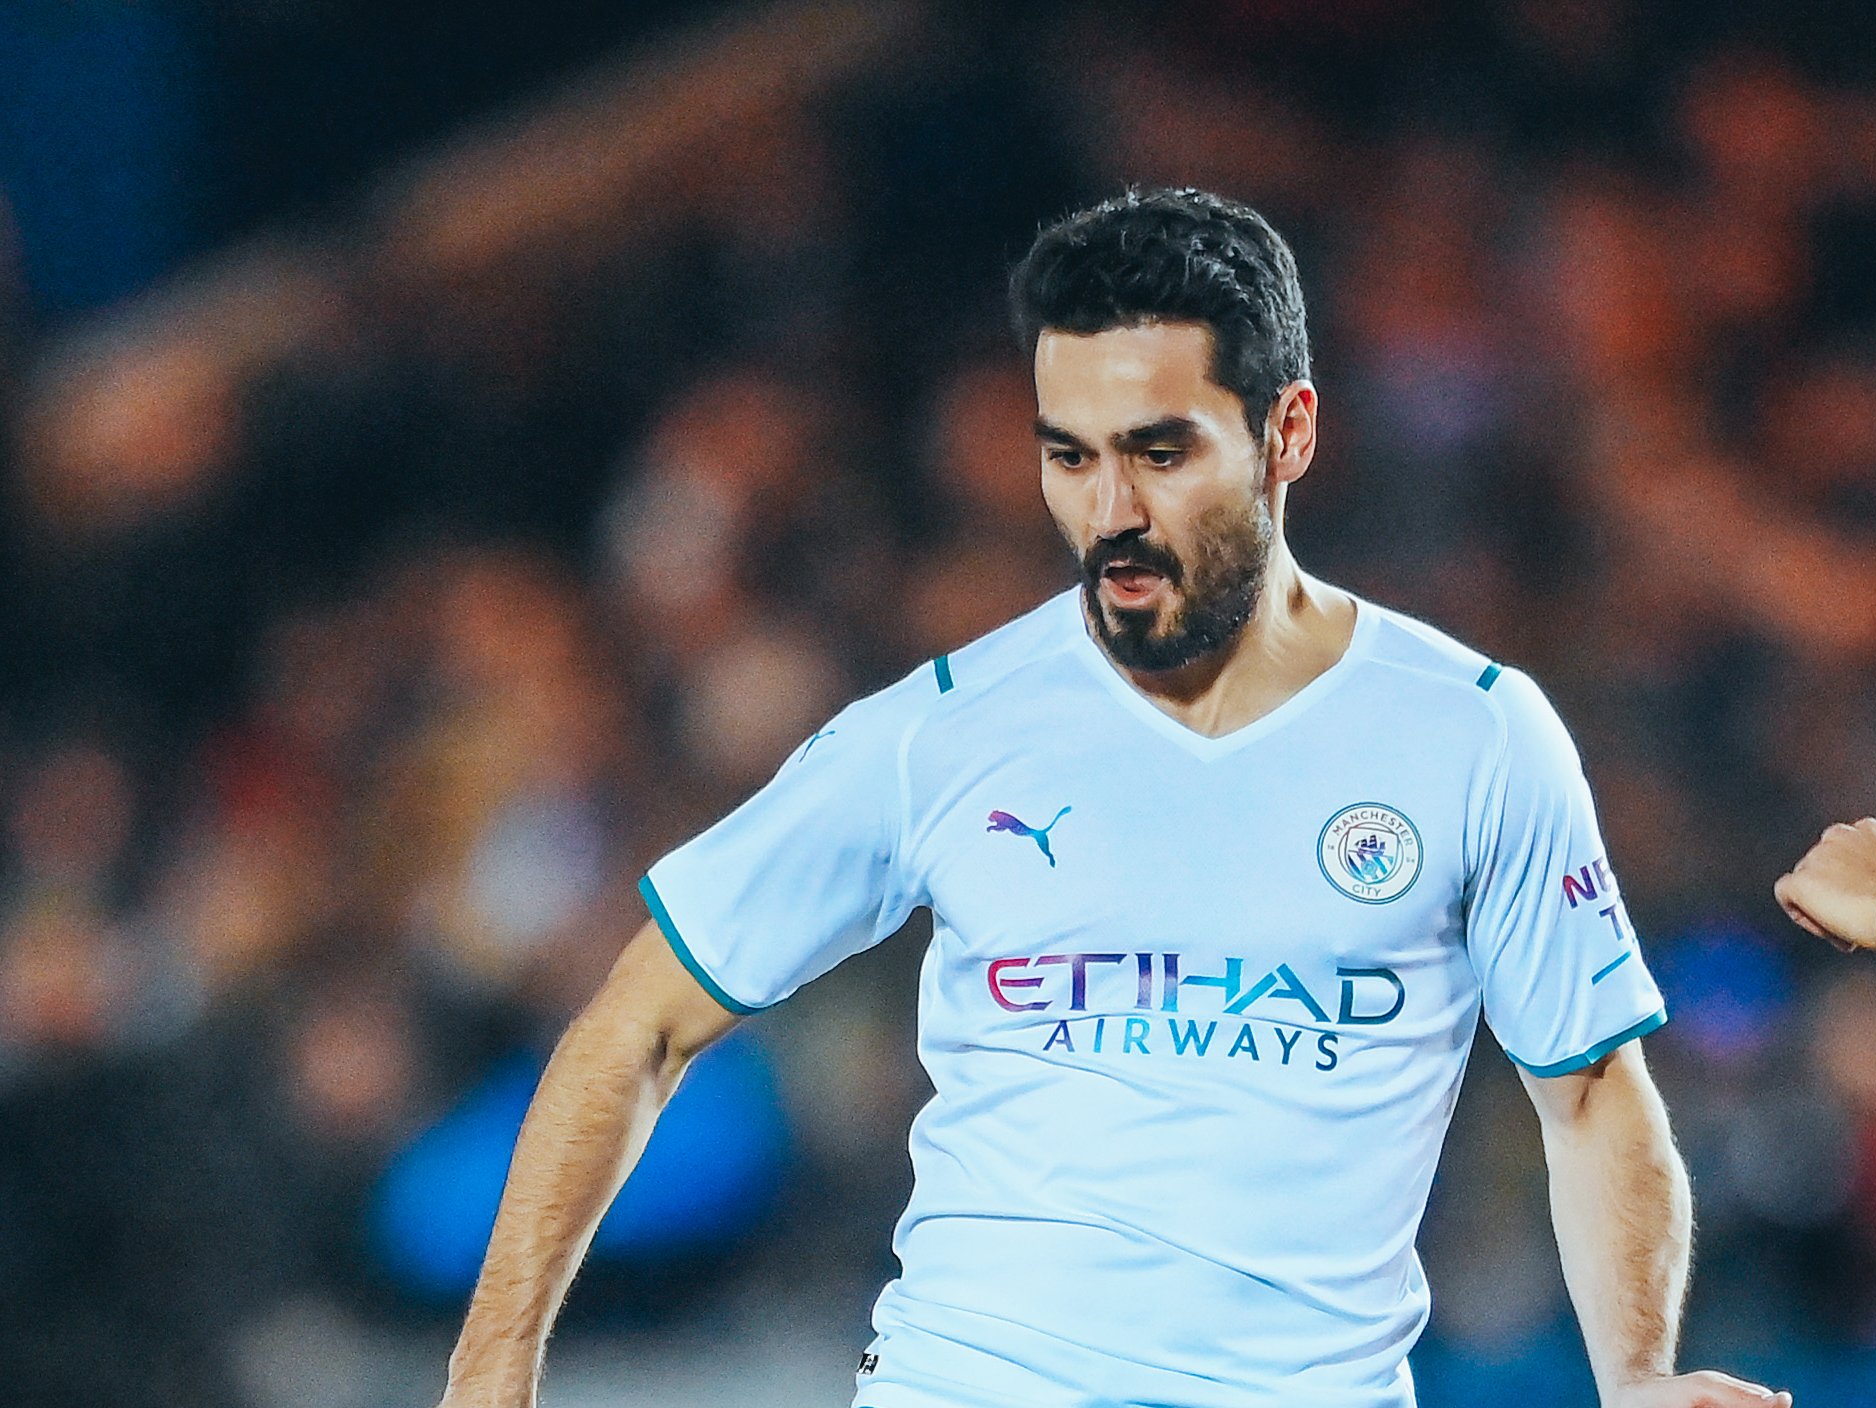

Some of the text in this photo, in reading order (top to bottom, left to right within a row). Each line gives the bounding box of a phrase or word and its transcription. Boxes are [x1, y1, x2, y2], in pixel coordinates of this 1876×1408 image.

[1332, 810, 1414, 847] MANCHESTER
[1352, 884, 1382, 897] CITY
[987, 953, 1407, 1026] ETIHAD
[1042, 1017, 1339, 1072] AIRWAYS
